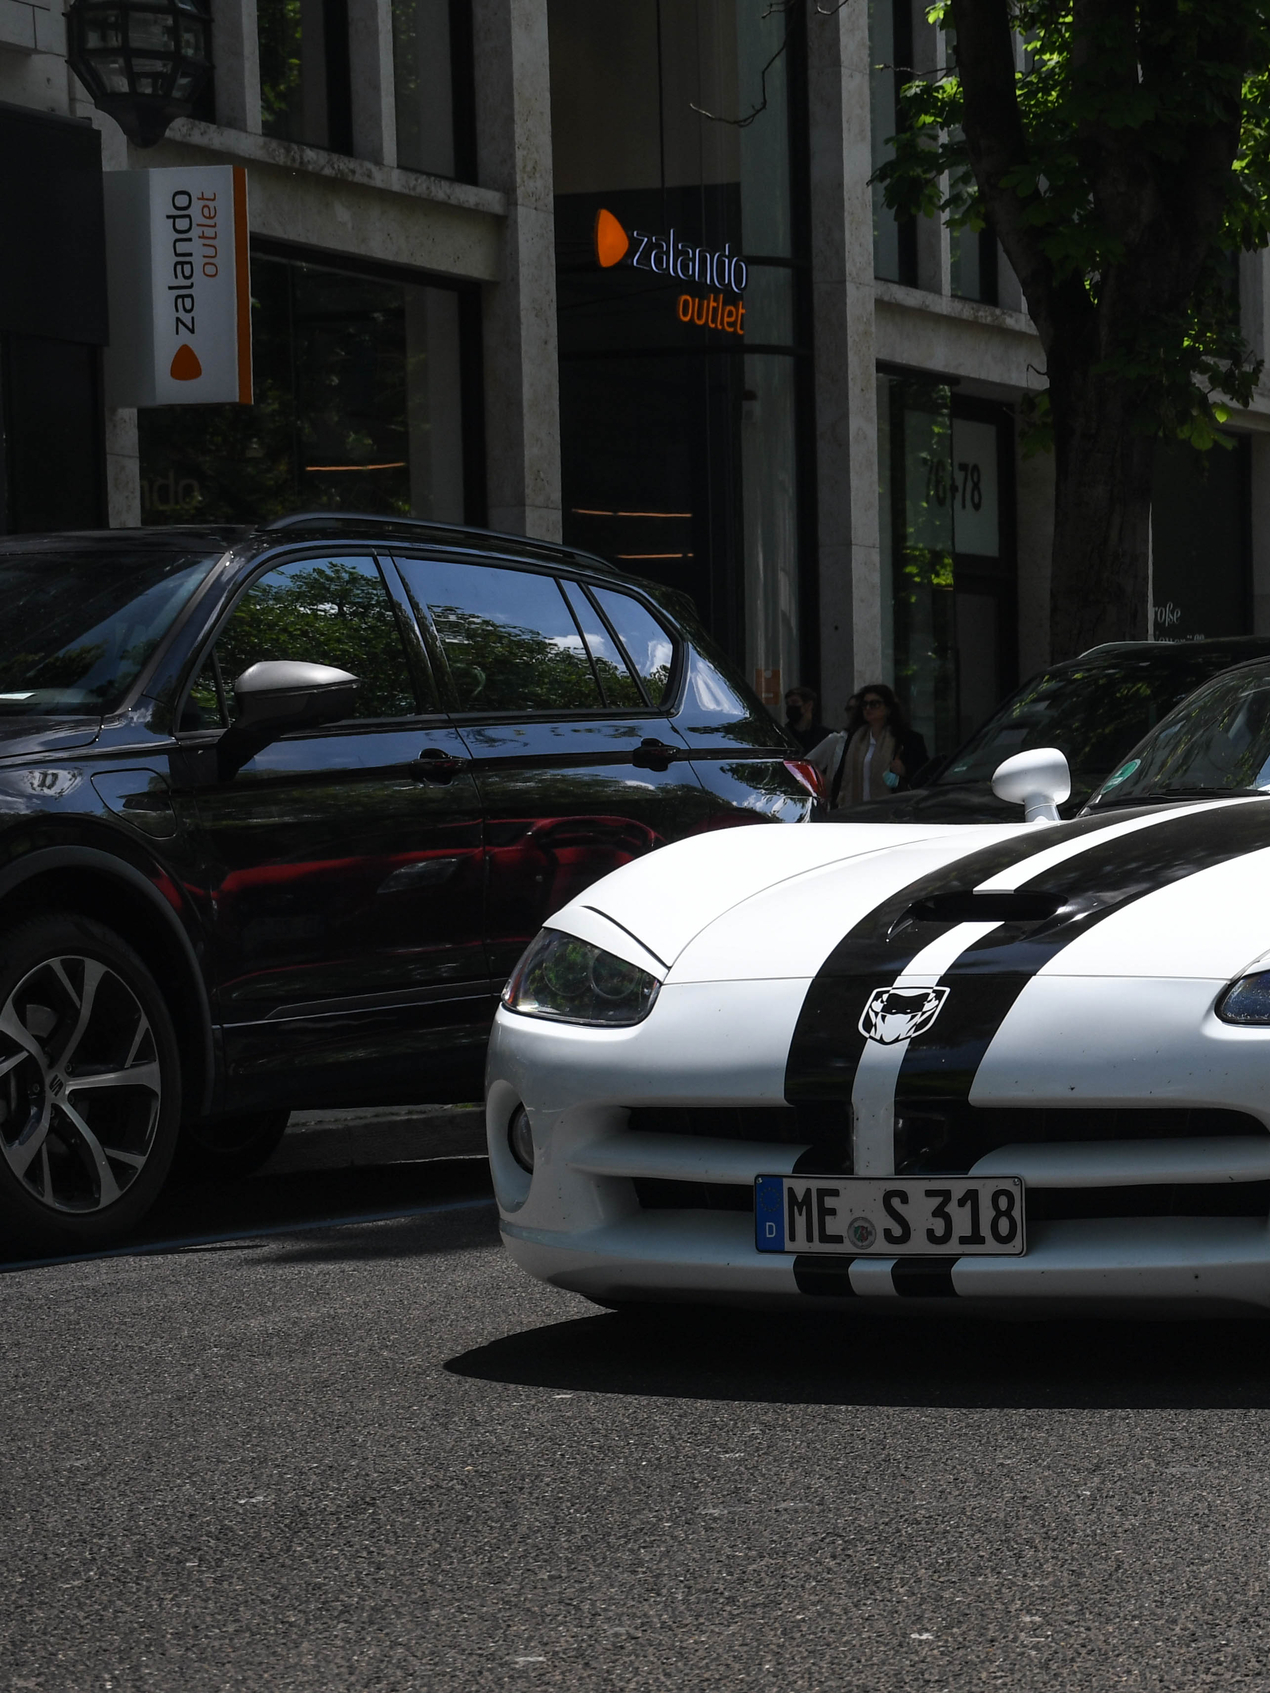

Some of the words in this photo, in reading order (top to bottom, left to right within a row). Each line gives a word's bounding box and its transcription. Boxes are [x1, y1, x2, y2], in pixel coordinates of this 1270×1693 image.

[166, 190, 195, 335] zalando
[197, 192, 218, 277] outlet
[633, 228, 748, 293] zalando
[677, 293, 746, 335] outlet
[766, 1222, 776, 1238] D
[787, 1186, 844, 1244] ME
[882, 1189, 912, 1245] S
[924, 1188, 1018, 1245] 318
